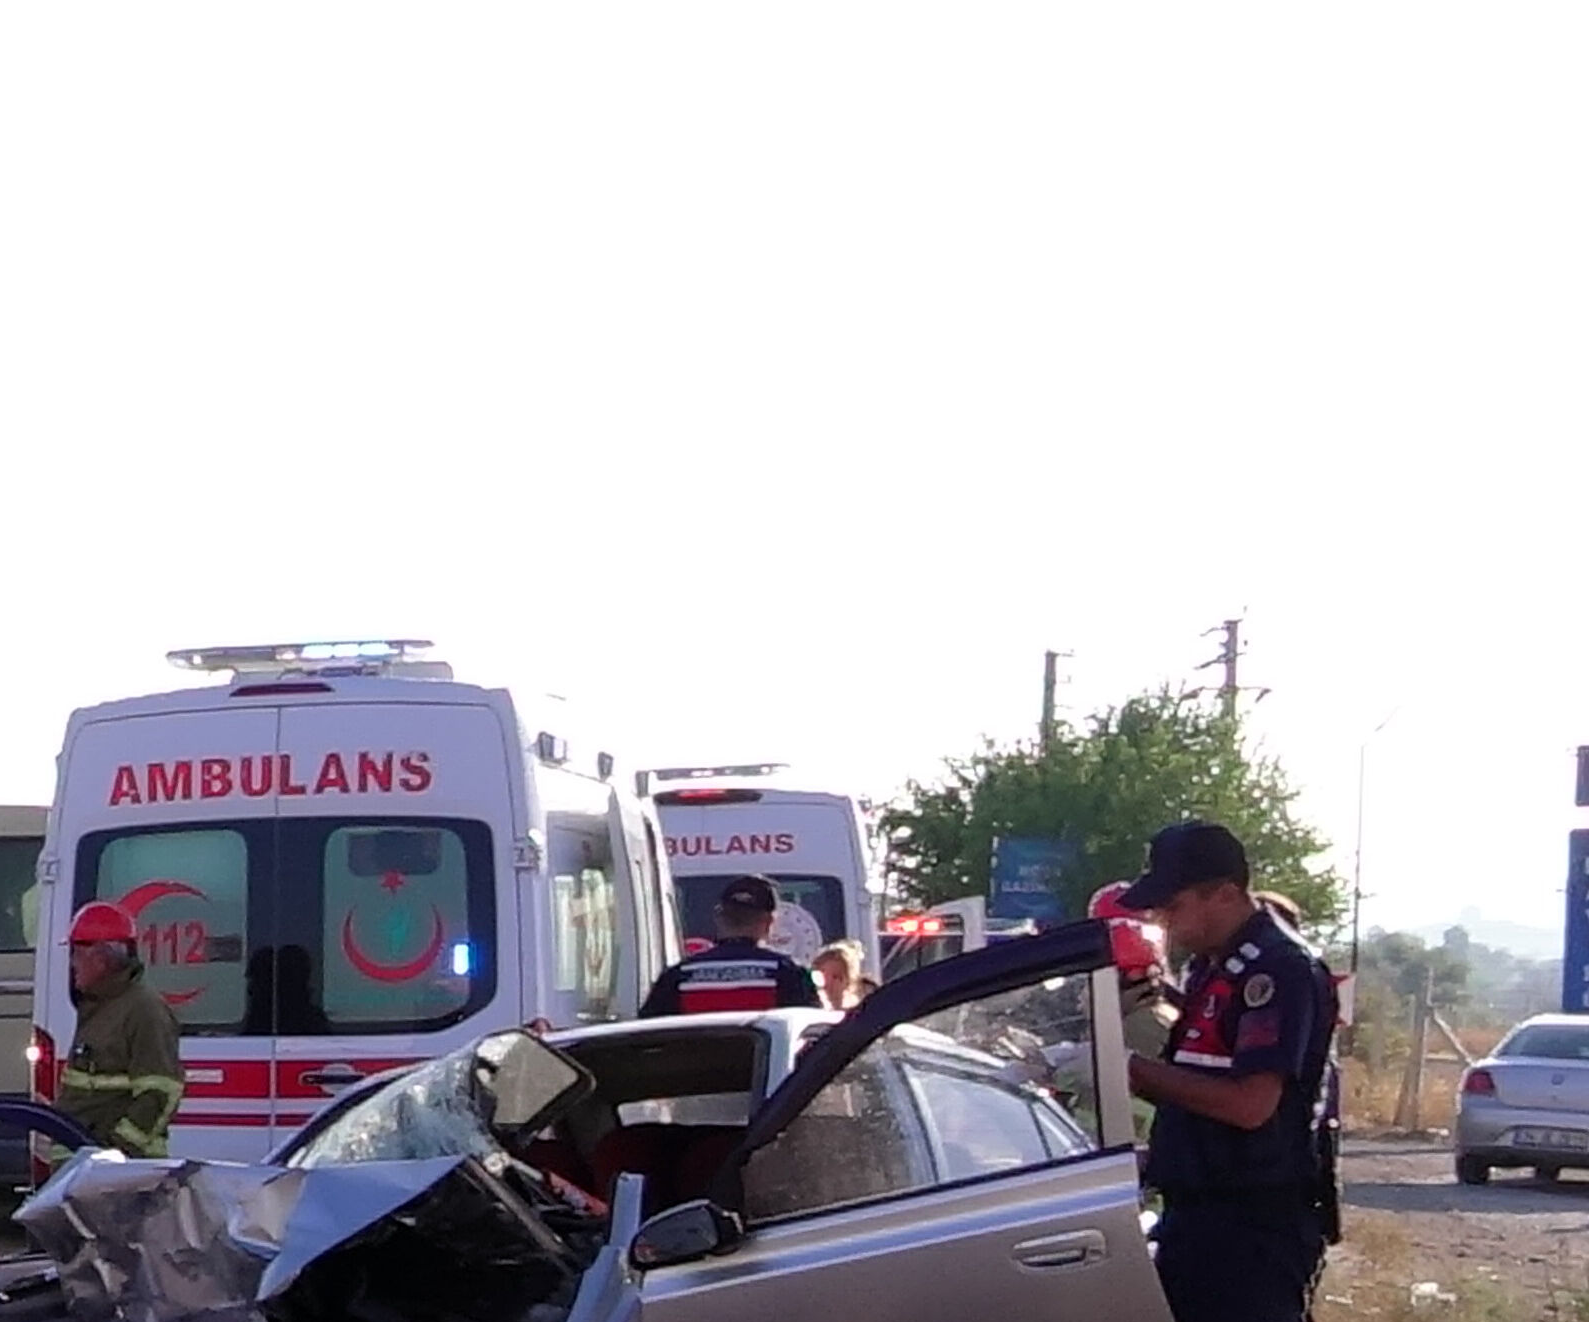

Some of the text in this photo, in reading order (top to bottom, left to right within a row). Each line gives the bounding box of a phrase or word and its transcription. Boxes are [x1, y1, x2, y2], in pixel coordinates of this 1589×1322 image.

[108, 751, 433, 806] AMBULANS
[663, 832, 795, 857] BULANS
[142, 921, 206, 965] 112
